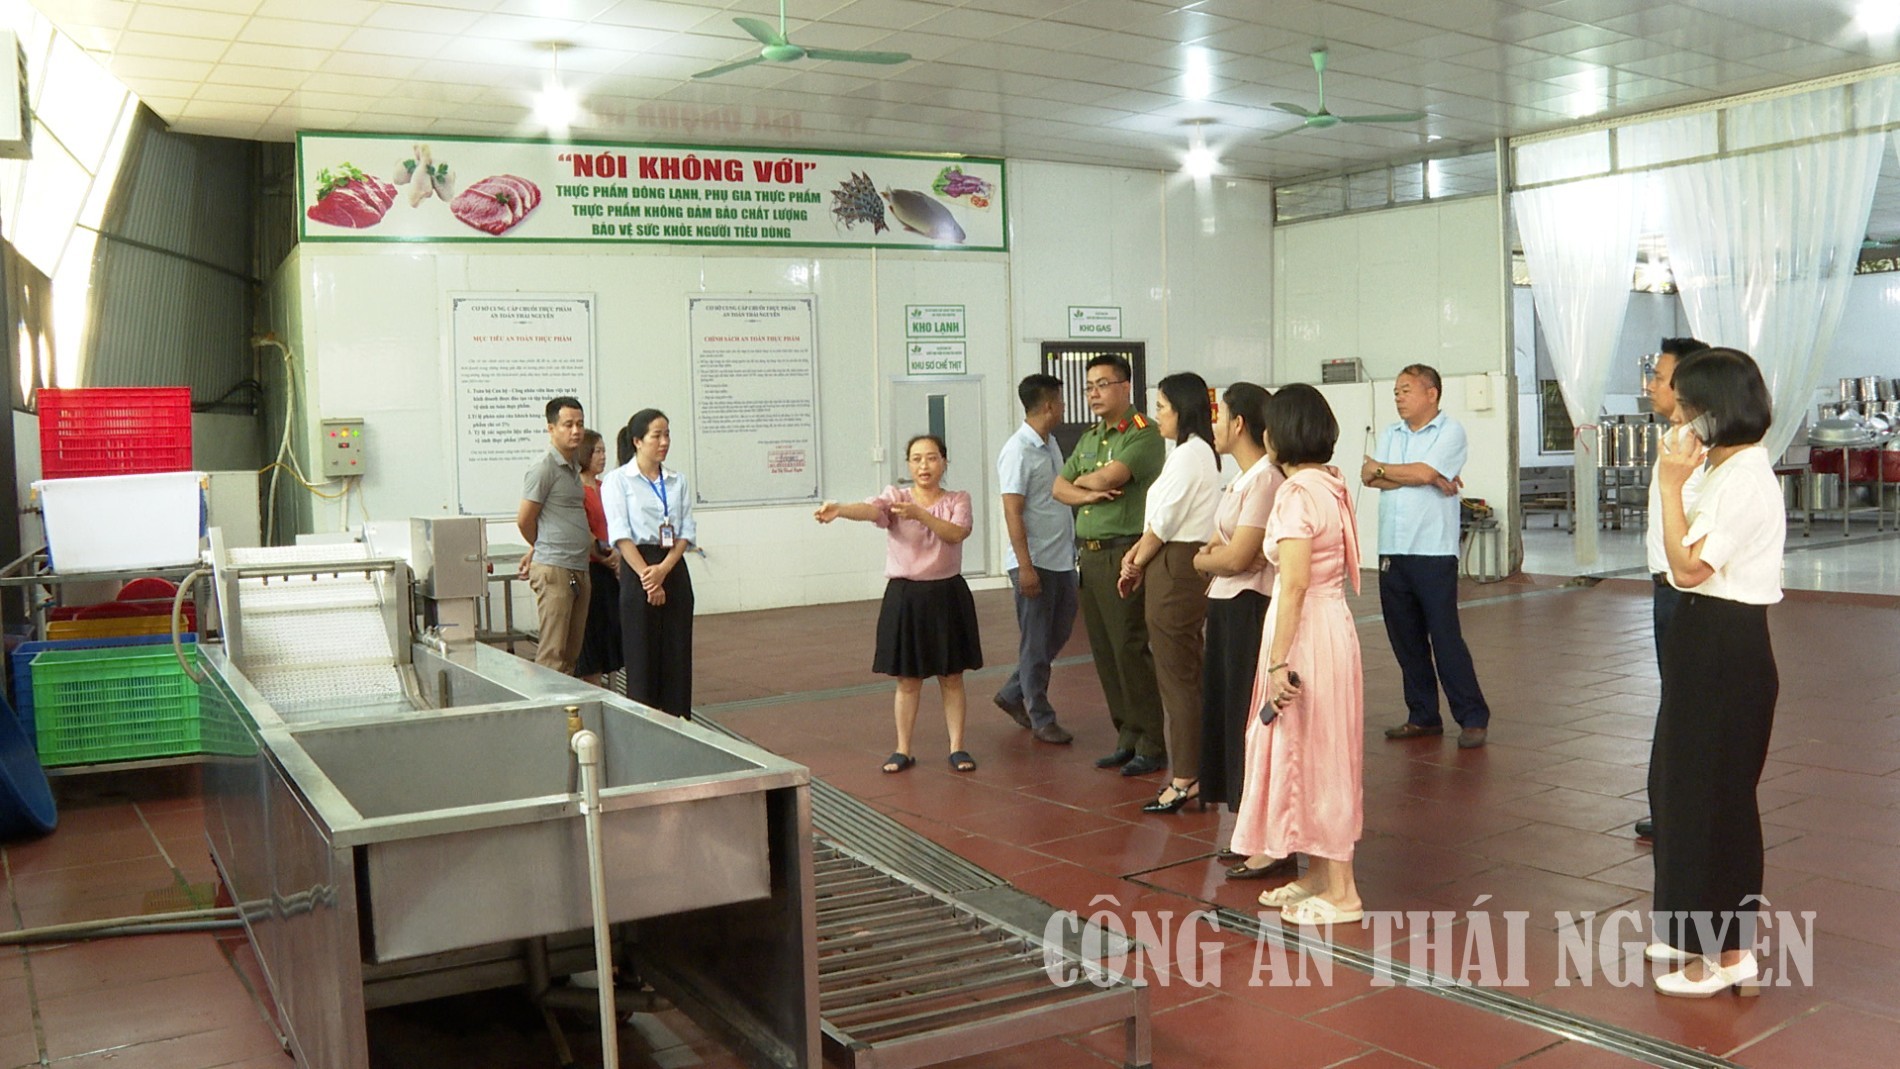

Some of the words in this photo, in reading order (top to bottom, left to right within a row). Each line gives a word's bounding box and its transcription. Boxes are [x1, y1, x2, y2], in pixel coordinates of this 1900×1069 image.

[638, 153, 744, 182] KHÔNG
[555, 184, 589, 199] THỰC
[632, 185, 665, 199] ĐÔNG
[705, 189, 728, 203] PHỤ
[732, 190, 752, 201] GIA
[755, 189, 786, 204] THỰC
[572, 204, 604, 218] THỰC
[644, 204, 683, 218] KHÔNG
[741, 205, 770, 220] CHẤT
[773, 207, 808, 222] LƯỢNG
[619, 222, 633, 238] VỆ
[636, 222, 660, 237] SỨC
[696, 224, 731, 238] NGƯỜI
[734, 224, 758, 238] TIÊU
[761, 225, 791, 239] DÙNG
[912, 322, 932, 333] KHO
[934, 322, 960, 335] LẠNH
[1079, 324, 1095, 332] KHO
[1095, 324, 1112, 332] GAS
